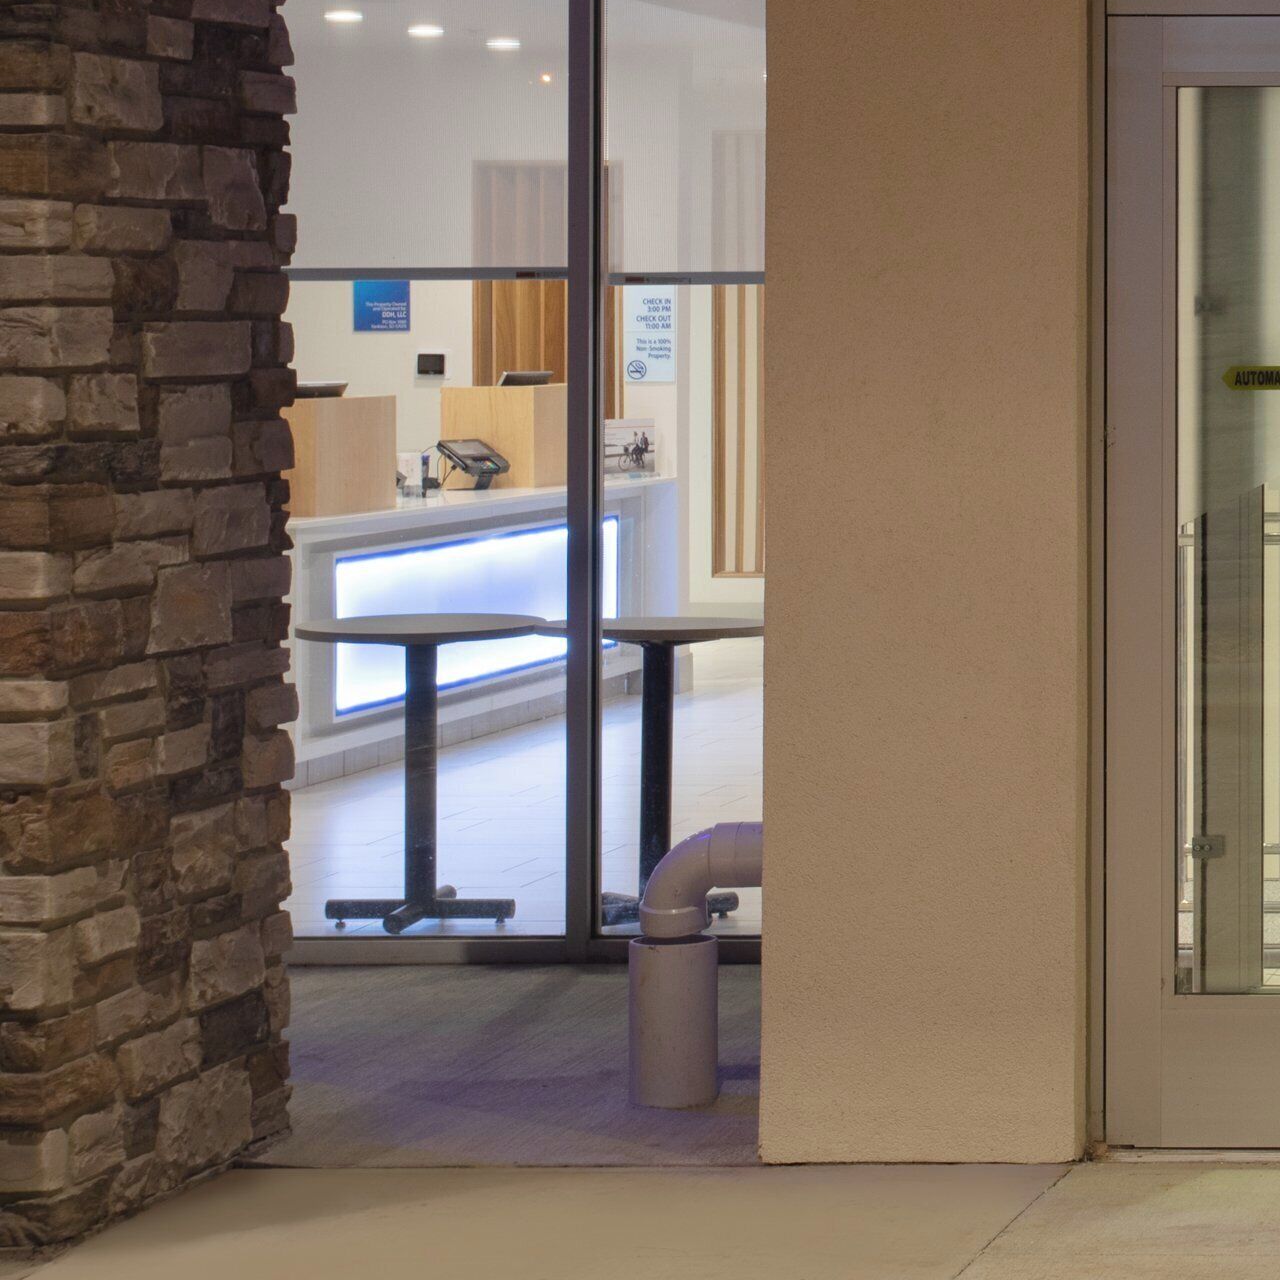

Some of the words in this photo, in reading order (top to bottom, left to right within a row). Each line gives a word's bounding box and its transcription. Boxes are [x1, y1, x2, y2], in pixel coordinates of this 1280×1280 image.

[636, 314, 657, 322] CHECK
[658, 314, 671, 322] OUT
[661, 322, 671, 330] AM
